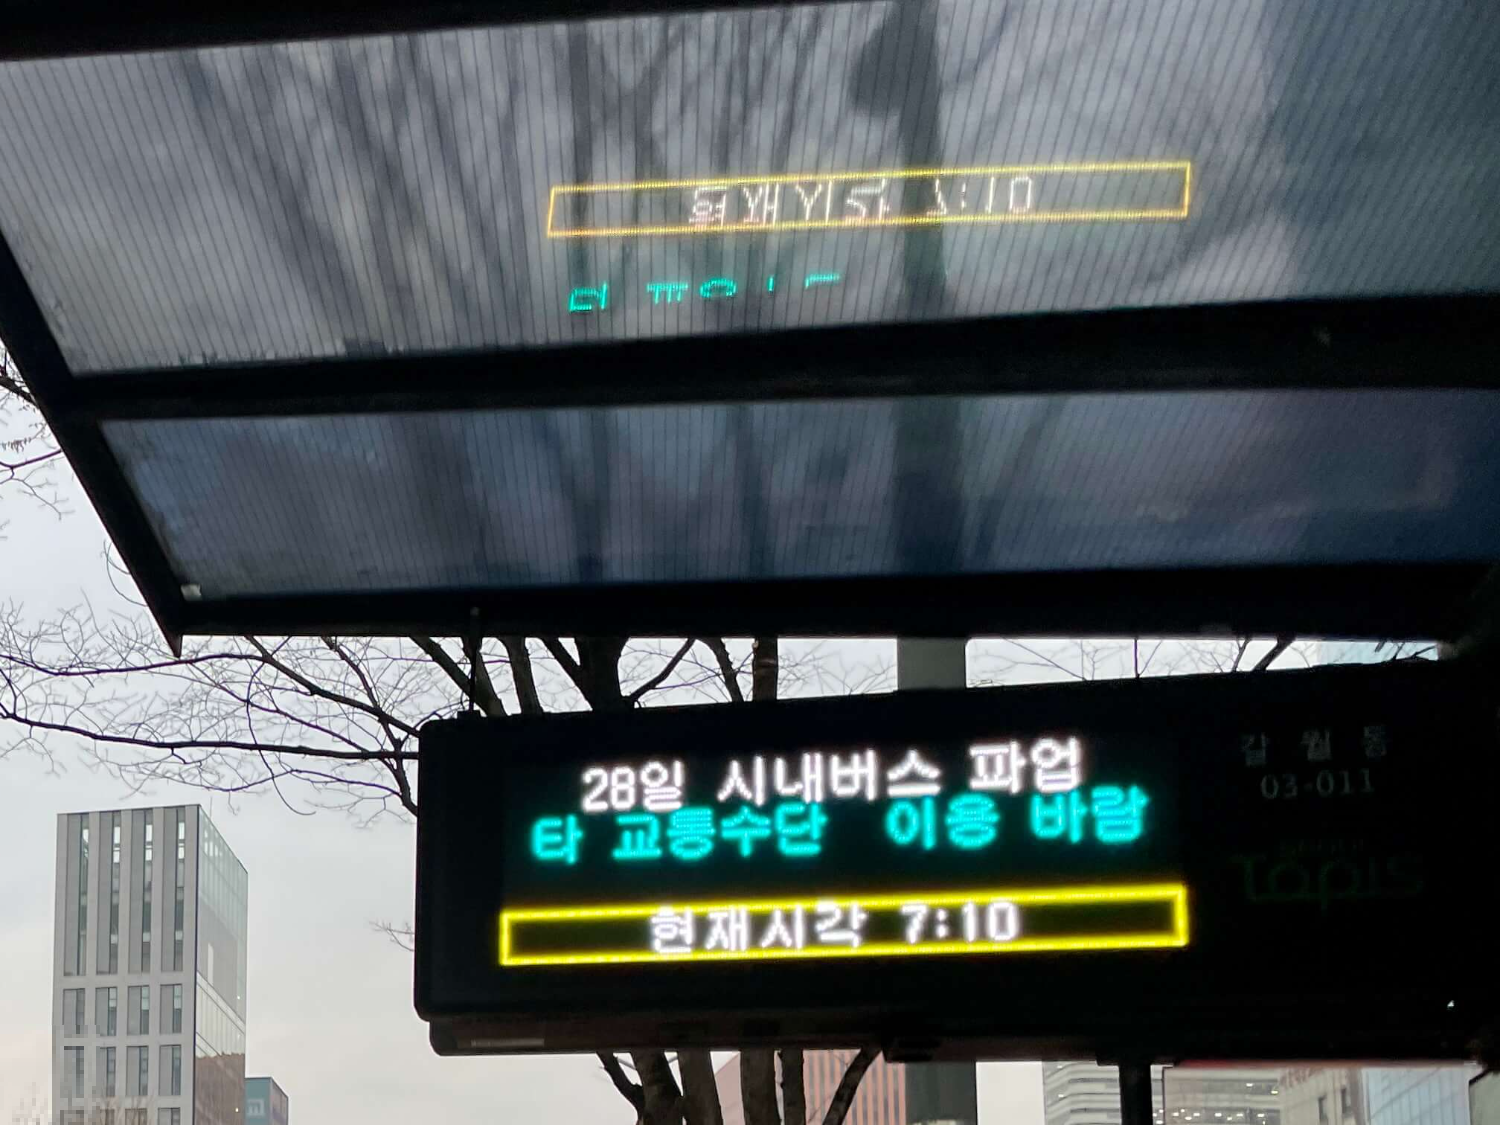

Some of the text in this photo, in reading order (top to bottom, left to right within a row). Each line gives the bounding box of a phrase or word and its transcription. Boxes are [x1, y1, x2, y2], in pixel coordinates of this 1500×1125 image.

[581, 738, 1082, 812] 28일 시내버스 파업
[1261, 769, 1374, 799] 03-011
[530, 785, 1148, 864] 타 교통수단 이용 바람
[650, 902, 1020, 955] 현재시각 7:10
